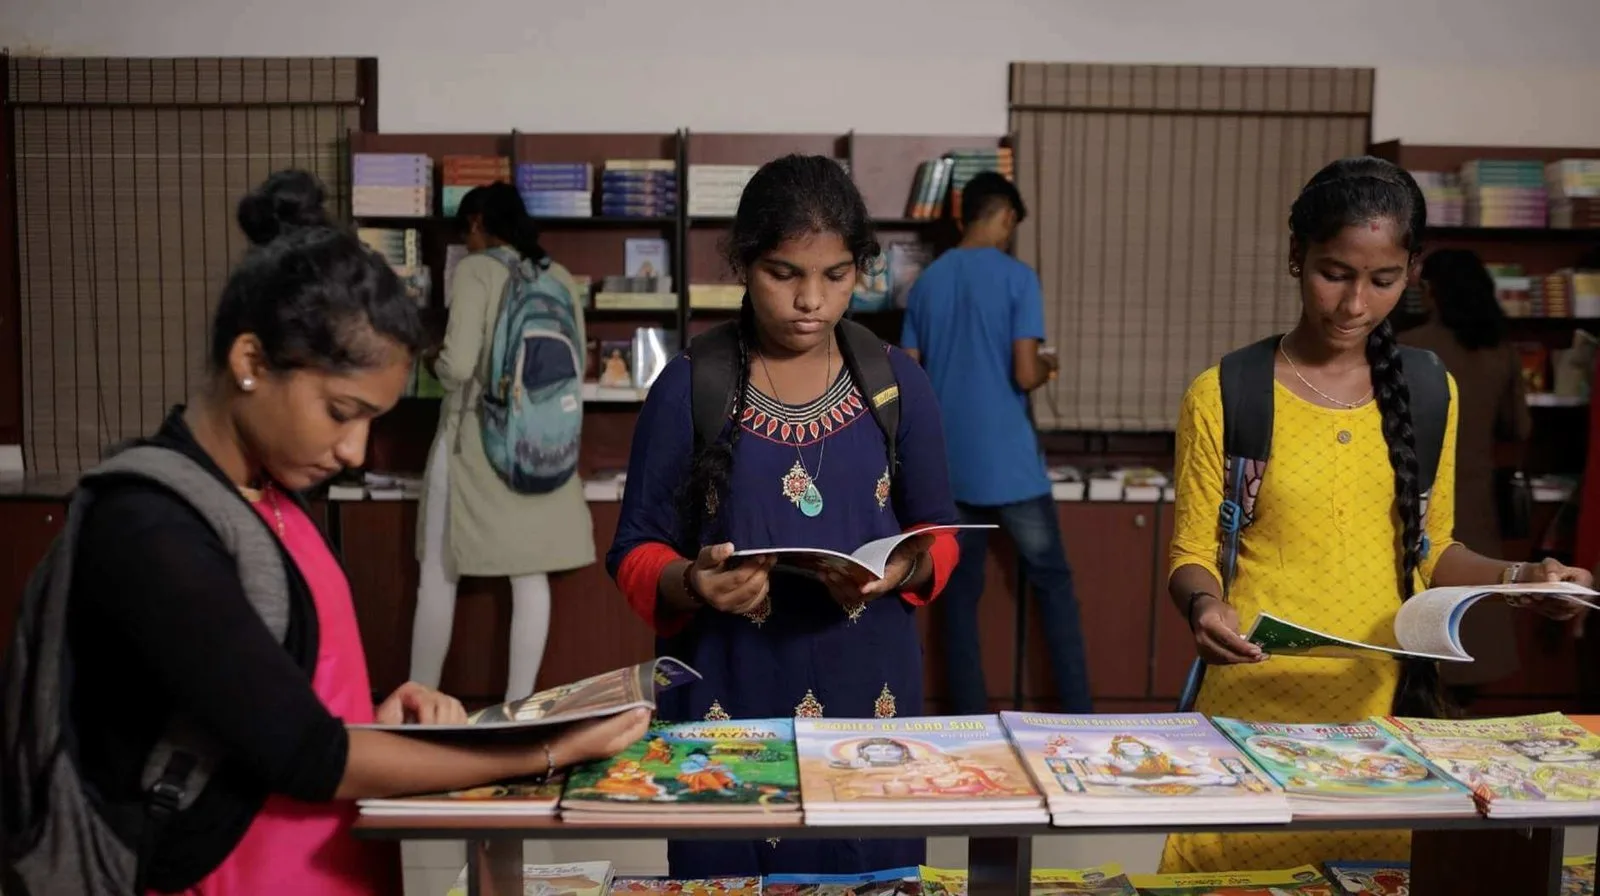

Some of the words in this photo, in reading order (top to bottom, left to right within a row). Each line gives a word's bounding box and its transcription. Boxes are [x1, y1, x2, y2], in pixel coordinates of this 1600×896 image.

[905, 721, 943, 731] LORD
[949, 720, 985, 731] SIVA
[669, 730, 777, 739] RAMAYANA
